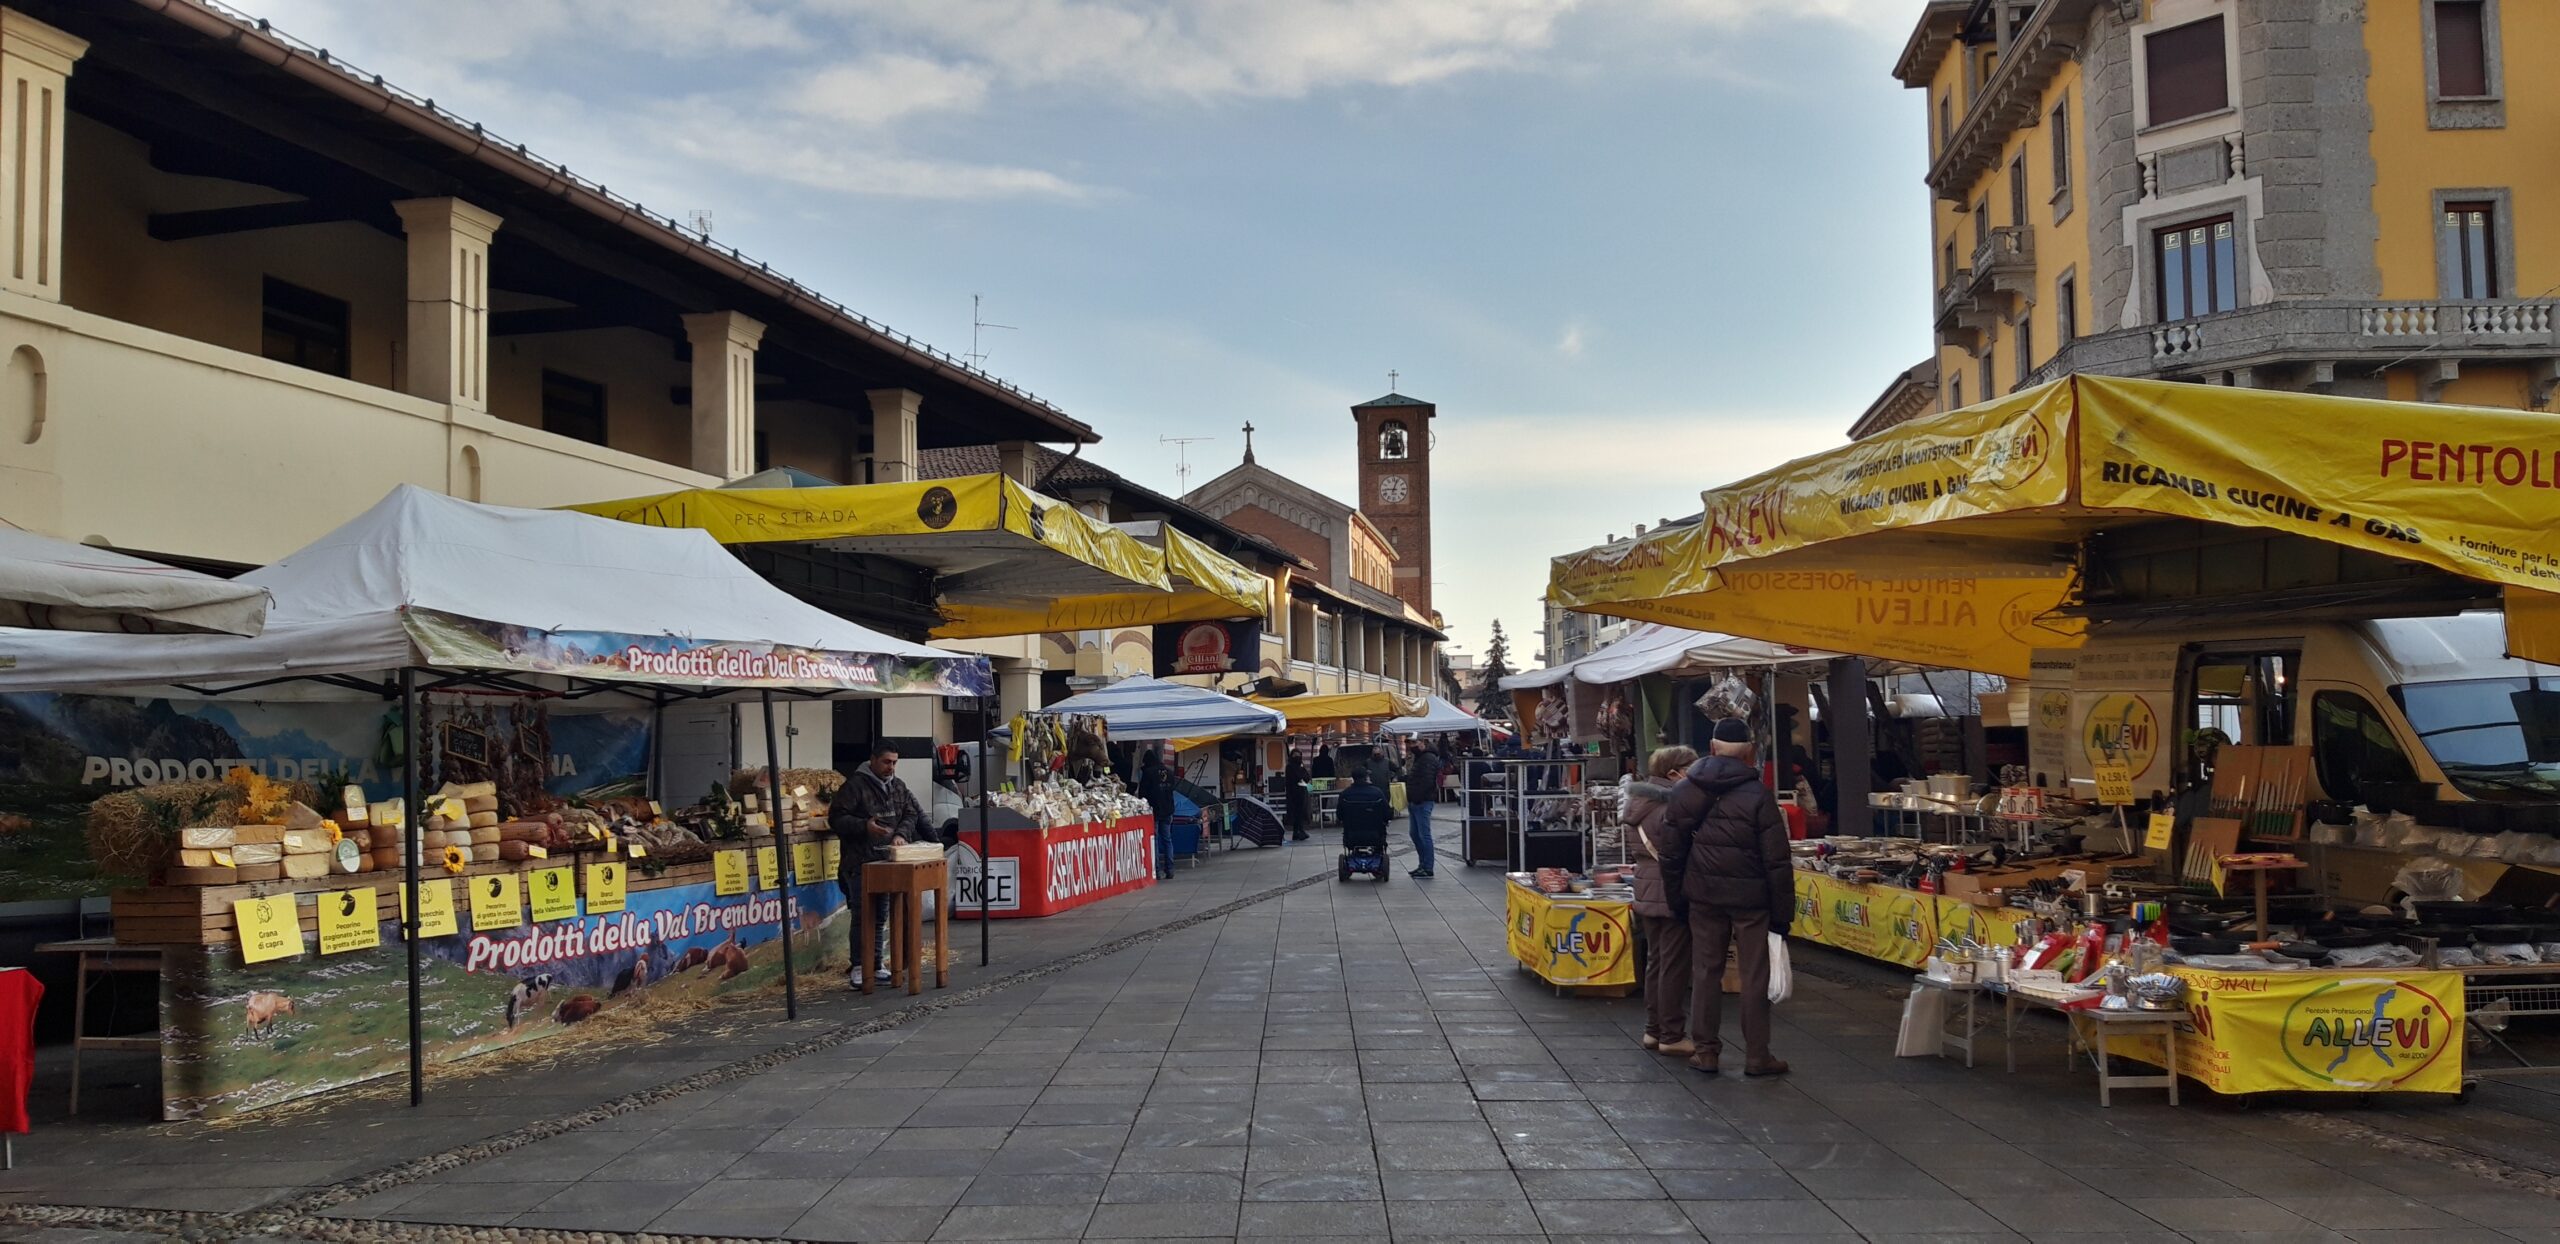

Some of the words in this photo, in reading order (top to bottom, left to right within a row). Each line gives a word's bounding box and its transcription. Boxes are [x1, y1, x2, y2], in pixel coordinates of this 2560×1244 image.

[2381, 439, 2560, 489] PENTOL
[1887, 482, 1929, 506] CUCINE
[1933, 479, 1943, 498] A
[1947, 473, 1969, 495] GAS
[2102, 460, 2217, 500] RICAMBI
[2226, 487, 2323, 523] CUCINE
[2328, 512, 2351, 528] A
[2365, 517, 2423, 545] GAS
[734, 512, 766, 526] PER
[781, 509, 859, 524] STRADA
[2459, 535, 2518, 559] Forniture
[2521, 551, 2543, 567] per
[2546, 553, 2559, 567] la
[2513, 563, 2526, 575] al
[628, 644, 714, 678] Prodotti
[718, 651, 766, 678] della
[767, 652, 796, 680] Val
[797, 657, 878, 683] Brembana
[82, 756, 266, 786] PRODOTI
[258, 942, 265, 950] di
[266, 939, 284, 949] capra
[259, 930, 278, 939] Grana
[466, 919, 585, 974] Prodotti
[589, 910, 651, 954] della
[654, 902, 690, 943] Val
[2186, 974, 2269, 993] ESSIONALI
[2305, 1006, 2331, 1015] Pentole
